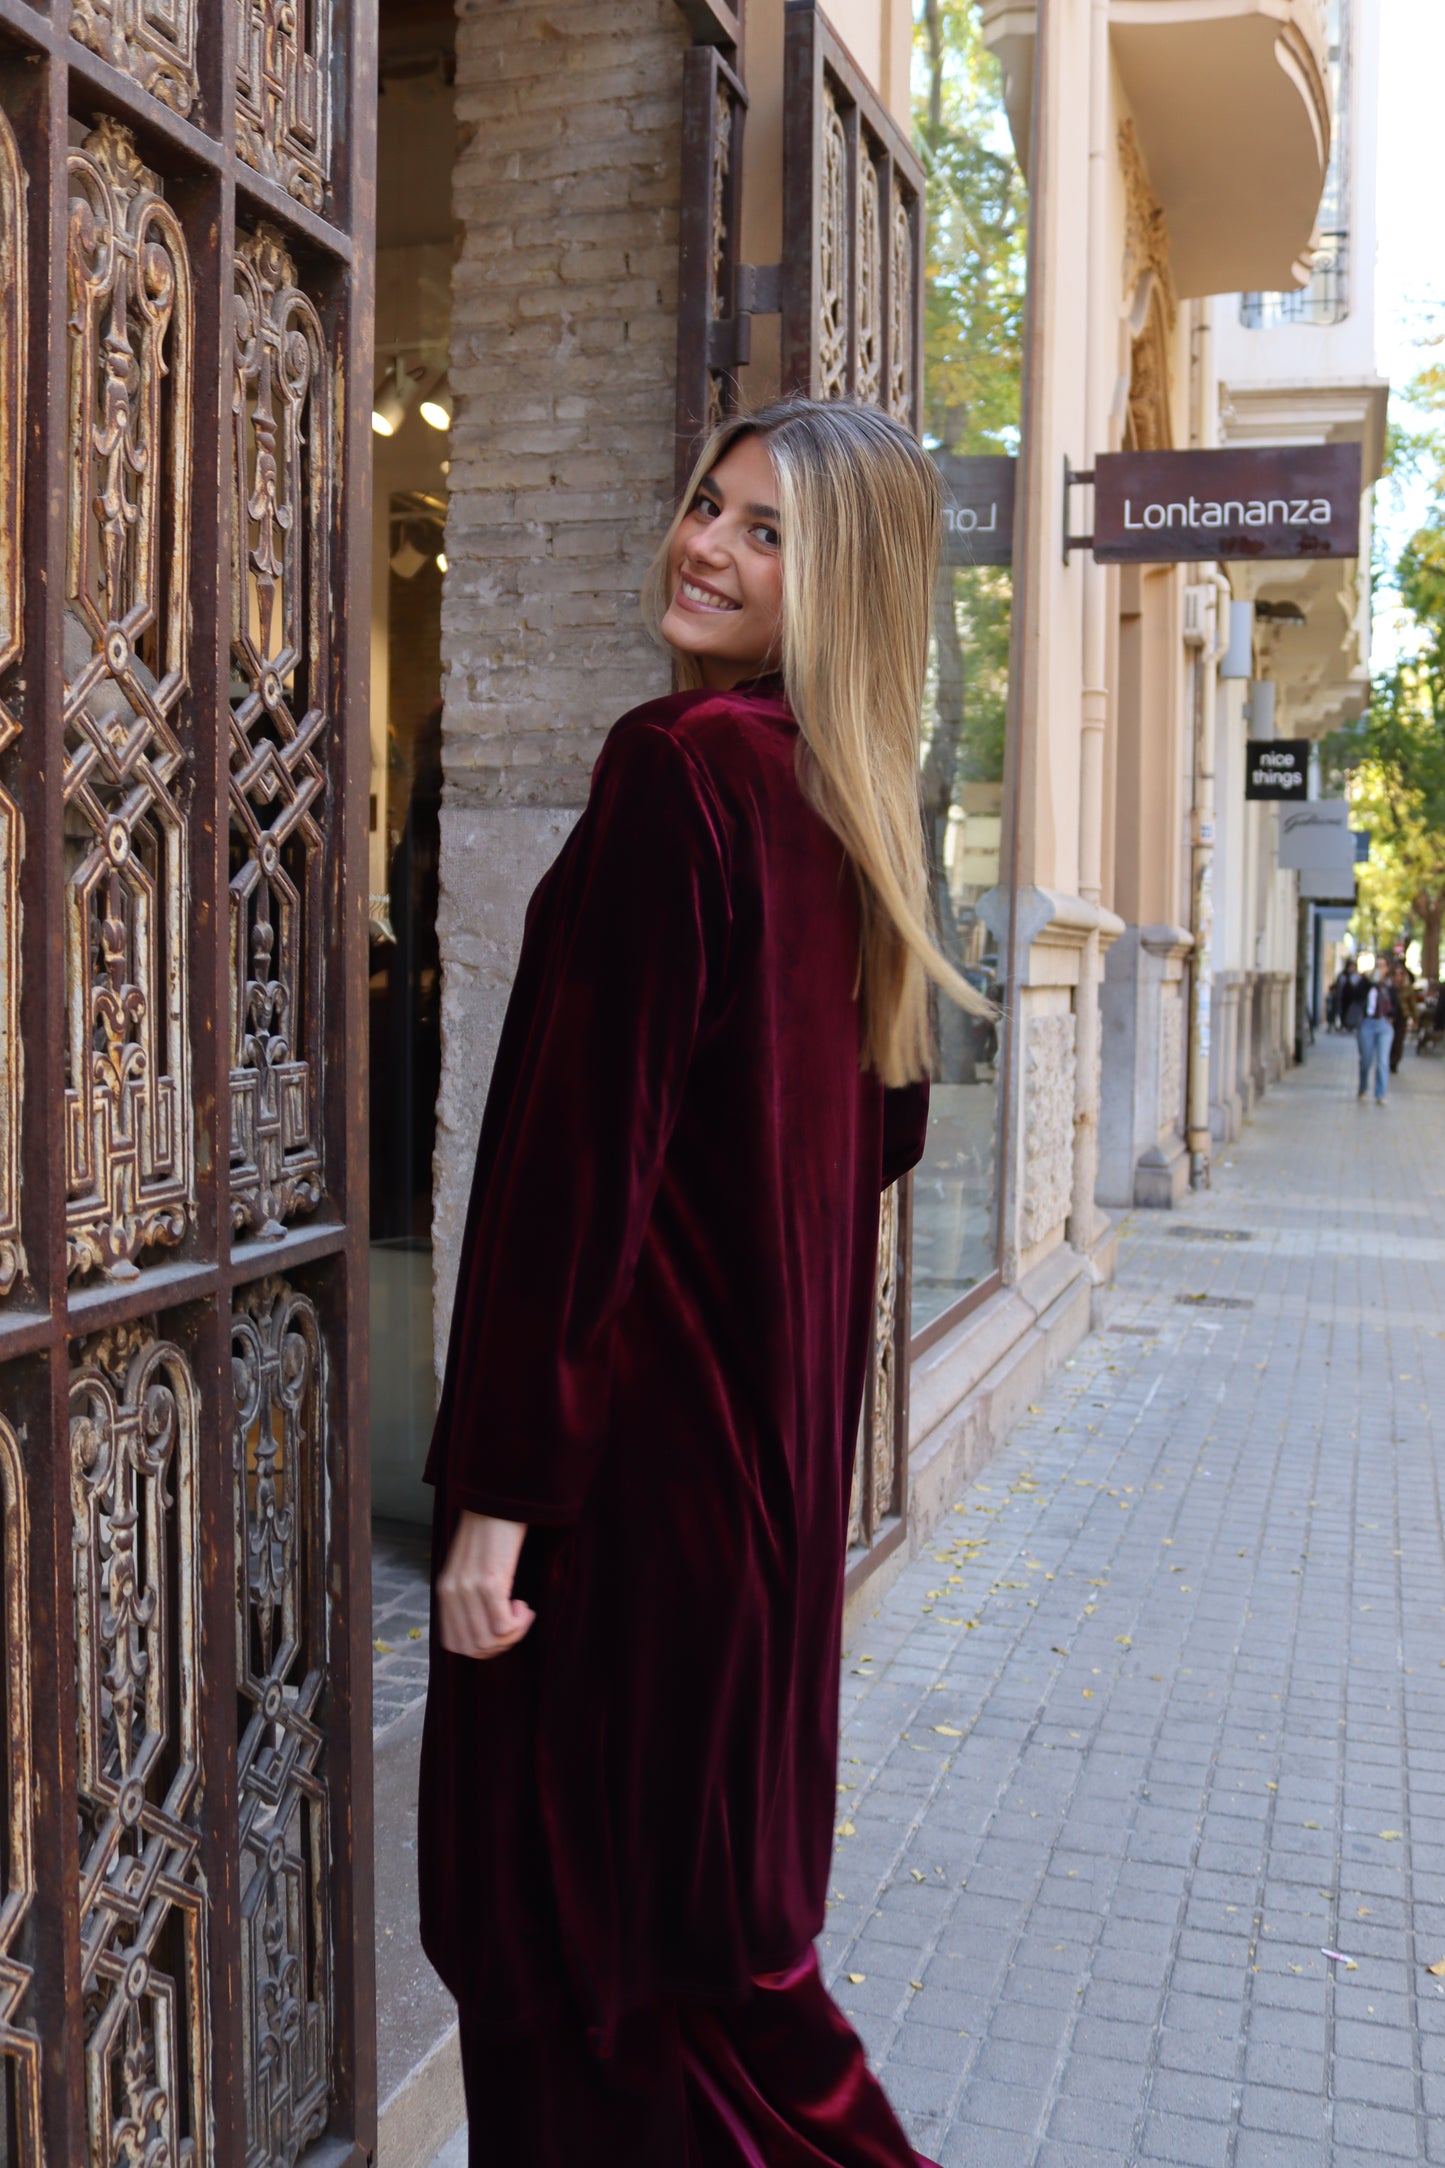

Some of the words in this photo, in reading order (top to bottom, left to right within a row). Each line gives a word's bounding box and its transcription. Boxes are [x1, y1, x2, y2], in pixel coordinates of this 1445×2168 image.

[1124, 496, 1332, 529] Lontananza
[1260, 751, 1295, 768] nice
[1252, 769, 1302, 789] things
